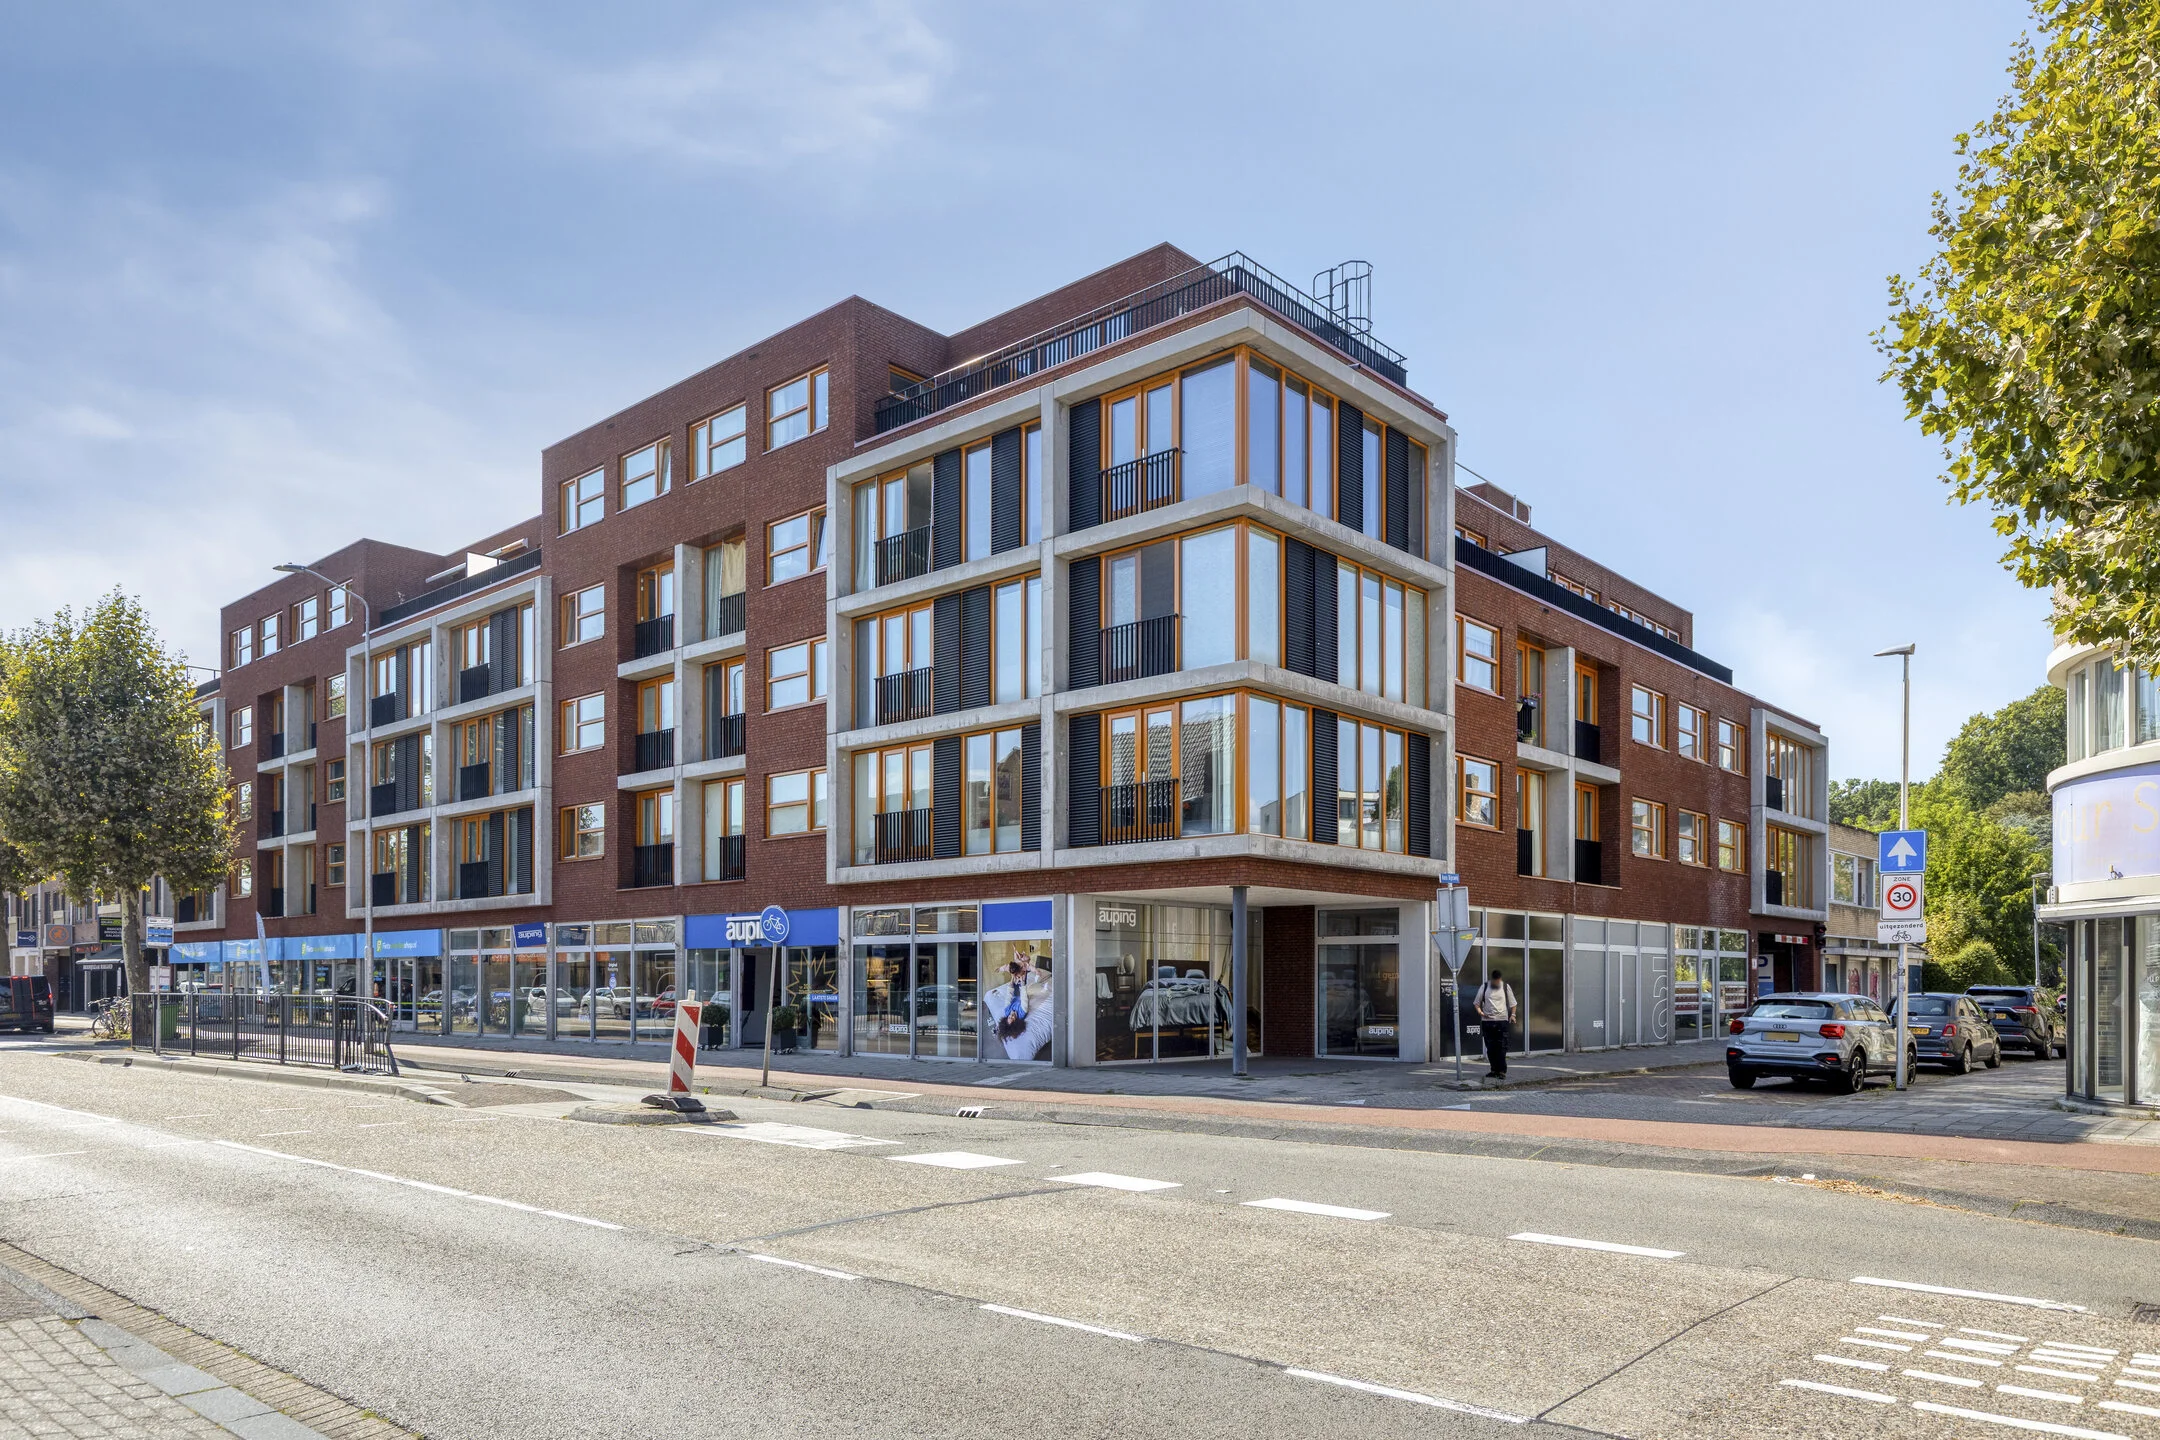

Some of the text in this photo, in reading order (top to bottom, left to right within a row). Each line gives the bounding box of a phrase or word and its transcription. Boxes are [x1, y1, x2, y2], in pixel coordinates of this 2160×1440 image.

[1892, 891, 1912, 903] 30
[1099, 907, 1136, 927] auping
[725, 916, 765, 945] aupi
[1879, 923, 1924, 931] uitgezonderd
[517, 929, 543, 940] auping
[889, 1023, 908, 1034] auping
[1368, 1025, 1394, 1036] auping
